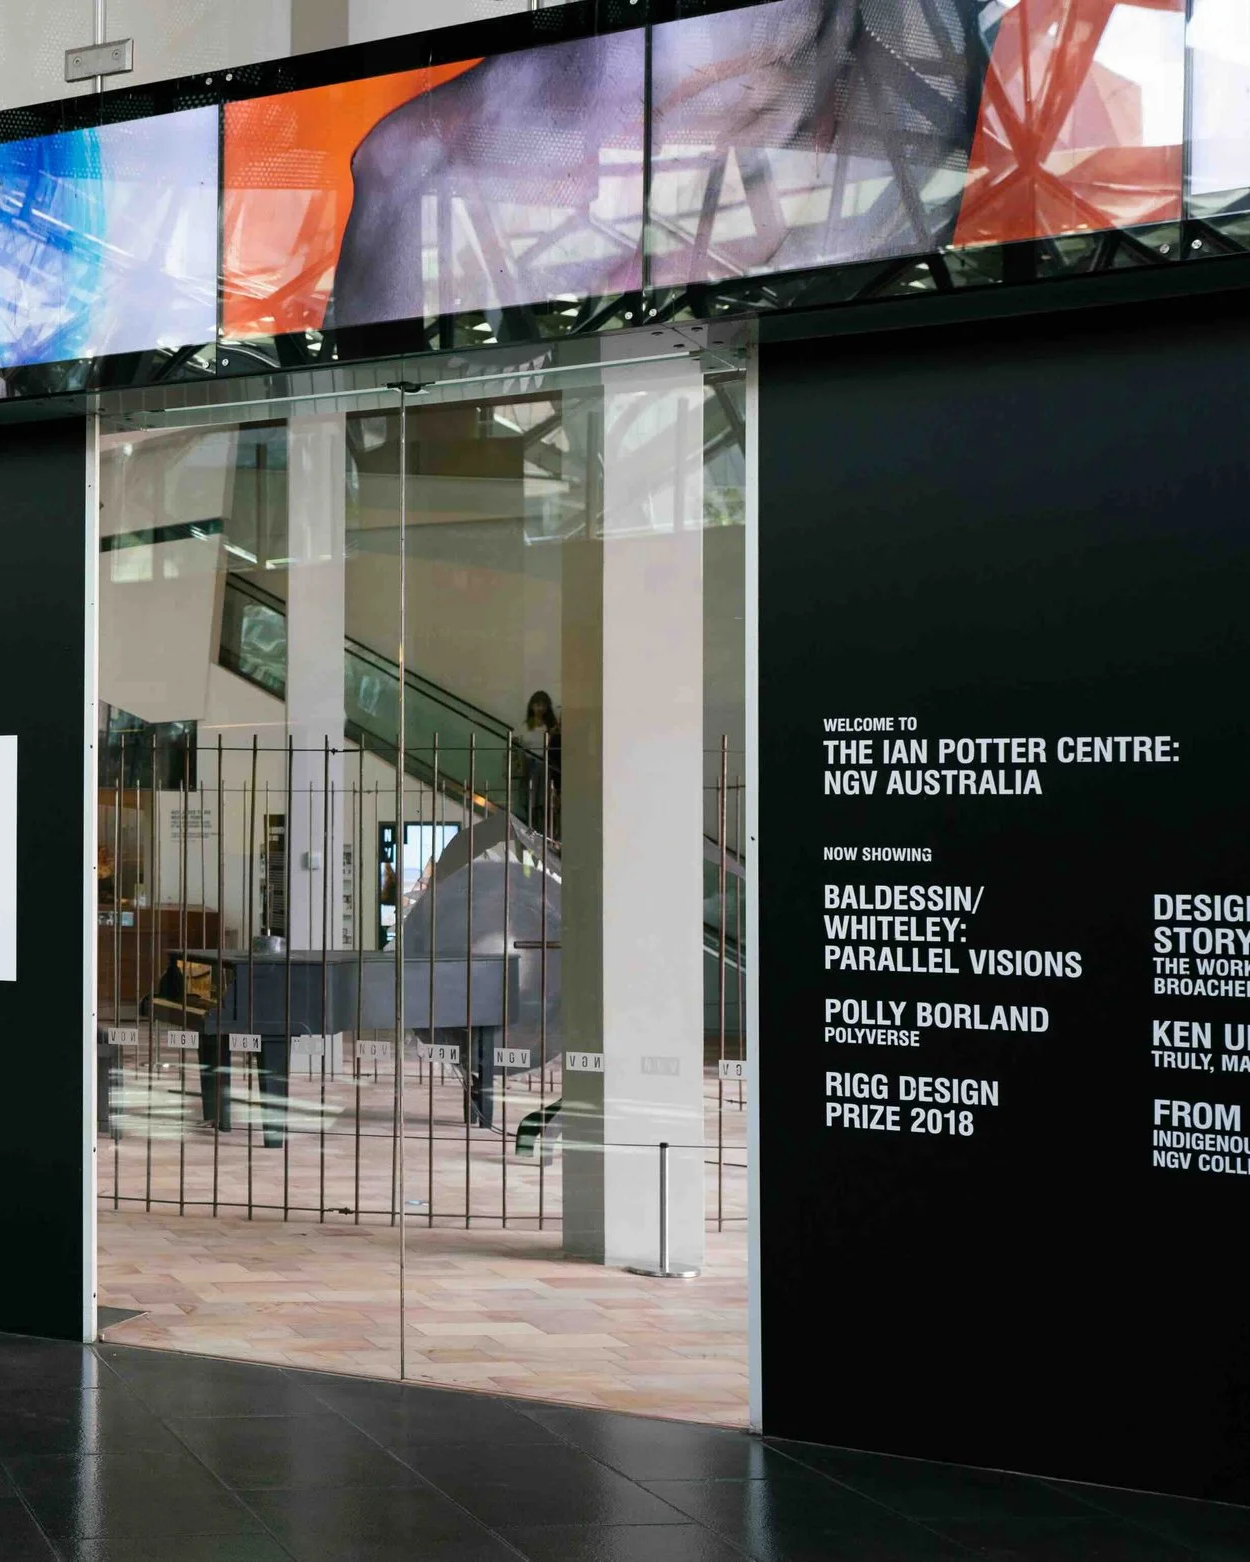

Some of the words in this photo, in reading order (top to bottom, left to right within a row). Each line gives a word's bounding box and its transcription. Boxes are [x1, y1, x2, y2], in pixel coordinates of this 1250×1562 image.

[823, 717, 895, 732] WELCOME
[898, 717, 918, 731] TO
[823, 739, 873, 765] THE
[883, 739, 928, 764] IAN
[938, 738, 1047, 764] POTTER
[1057, 736, 1180, 763] CENTRE:
[824, 769, 878, 795] NGV
[886, 769, 1043, 795] AUSTRALIA
[823, 847, 858, 861] NOW
[862, 847, 932, 862] SHOWING
[824, 884, 985, 914] BALDESSIN/
[1154, 894, 1250, 922] DESIG
[824, 914, 967, 943] WHITELEY:
[1154, 927, 1250, 955] STORY
[824, 945, 960, 974] PARALLEL
[969, 949, 1083, 978] VISIONS
[1154, 957, 1190, 975] THE
[1154, 977, 1250, 998] BROACHE
[825, 998, 906, 1026] POLLY
[917, 1002, 1049, 1032] BORLAND
[824, 1027, 920, 1047] POLYVERSE
[1153, 1019, 1212, 1048] KEN
[1224, 1024, 1250, 1051] U
[1151, 1051, 1215, 1074] TRULY,
[825, 1071, 889, 1100] RIGG
[899, 1076, 999, 1107] DESIGN
[825, 1102, 901, 1132] PRIZE
[910, 1108, 974, 1136] 2018
[1154, 1099, 1241, 1132] FROM
[1153, 1150, 1192, 1170] NGV
[1198, 1154, 1250, 1175] COLL
